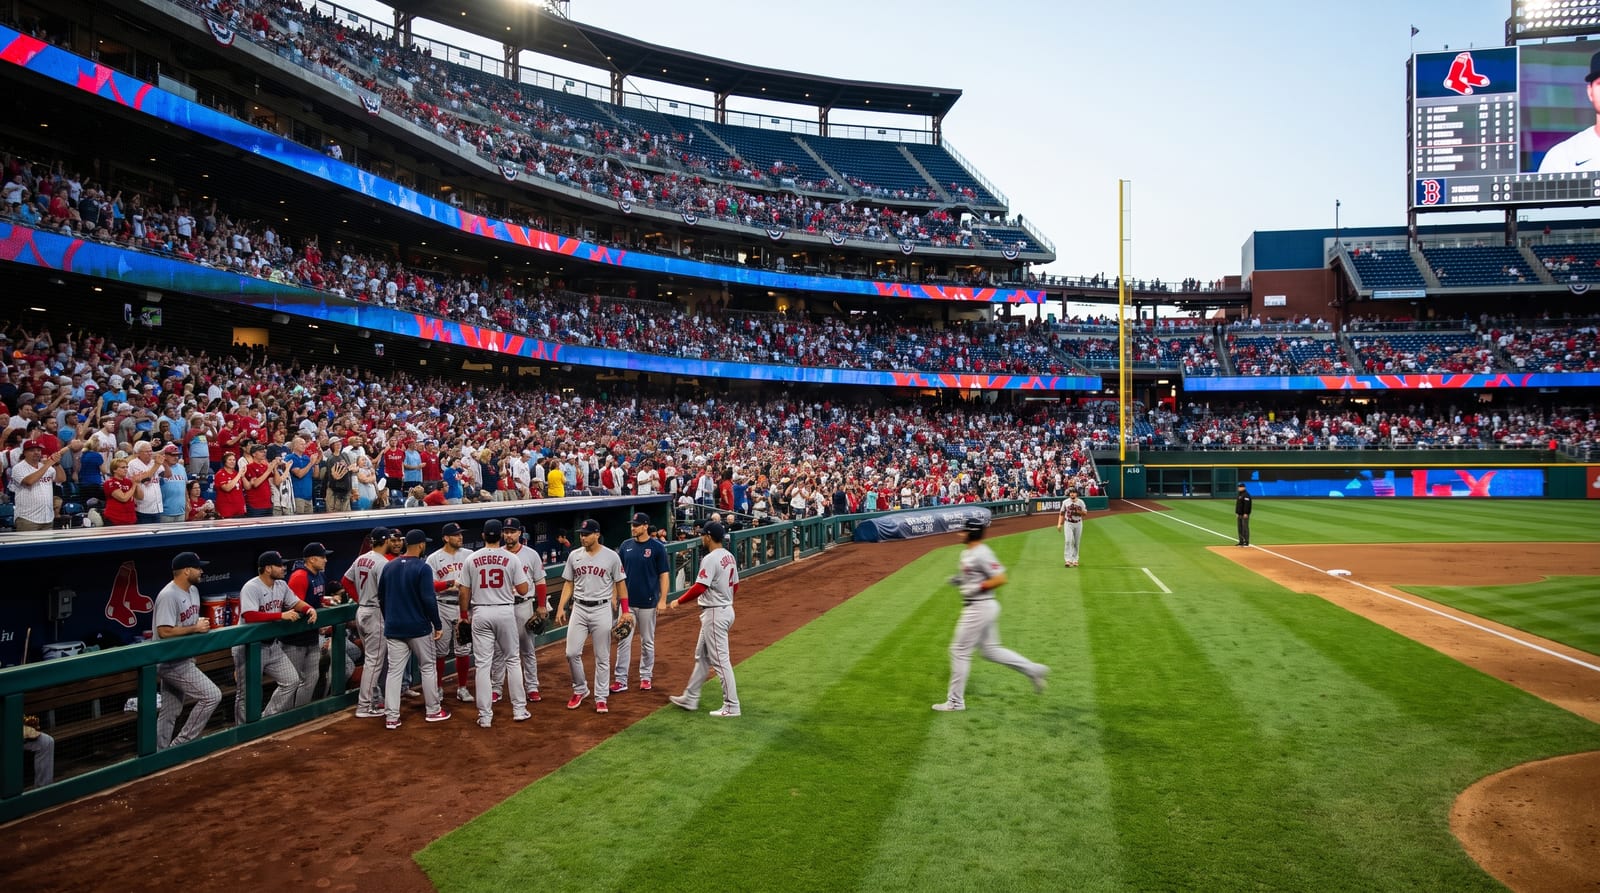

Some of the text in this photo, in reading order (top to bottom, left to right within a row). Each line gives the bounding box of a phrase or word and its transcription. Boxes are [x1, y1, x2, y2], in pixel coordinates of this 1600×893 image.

[1421, 179, 1440, 205] B
[359, 570, 369, 590] 7
[437, 562, 464, 579] BOSTO
[479, 568, 504, 589] 13
